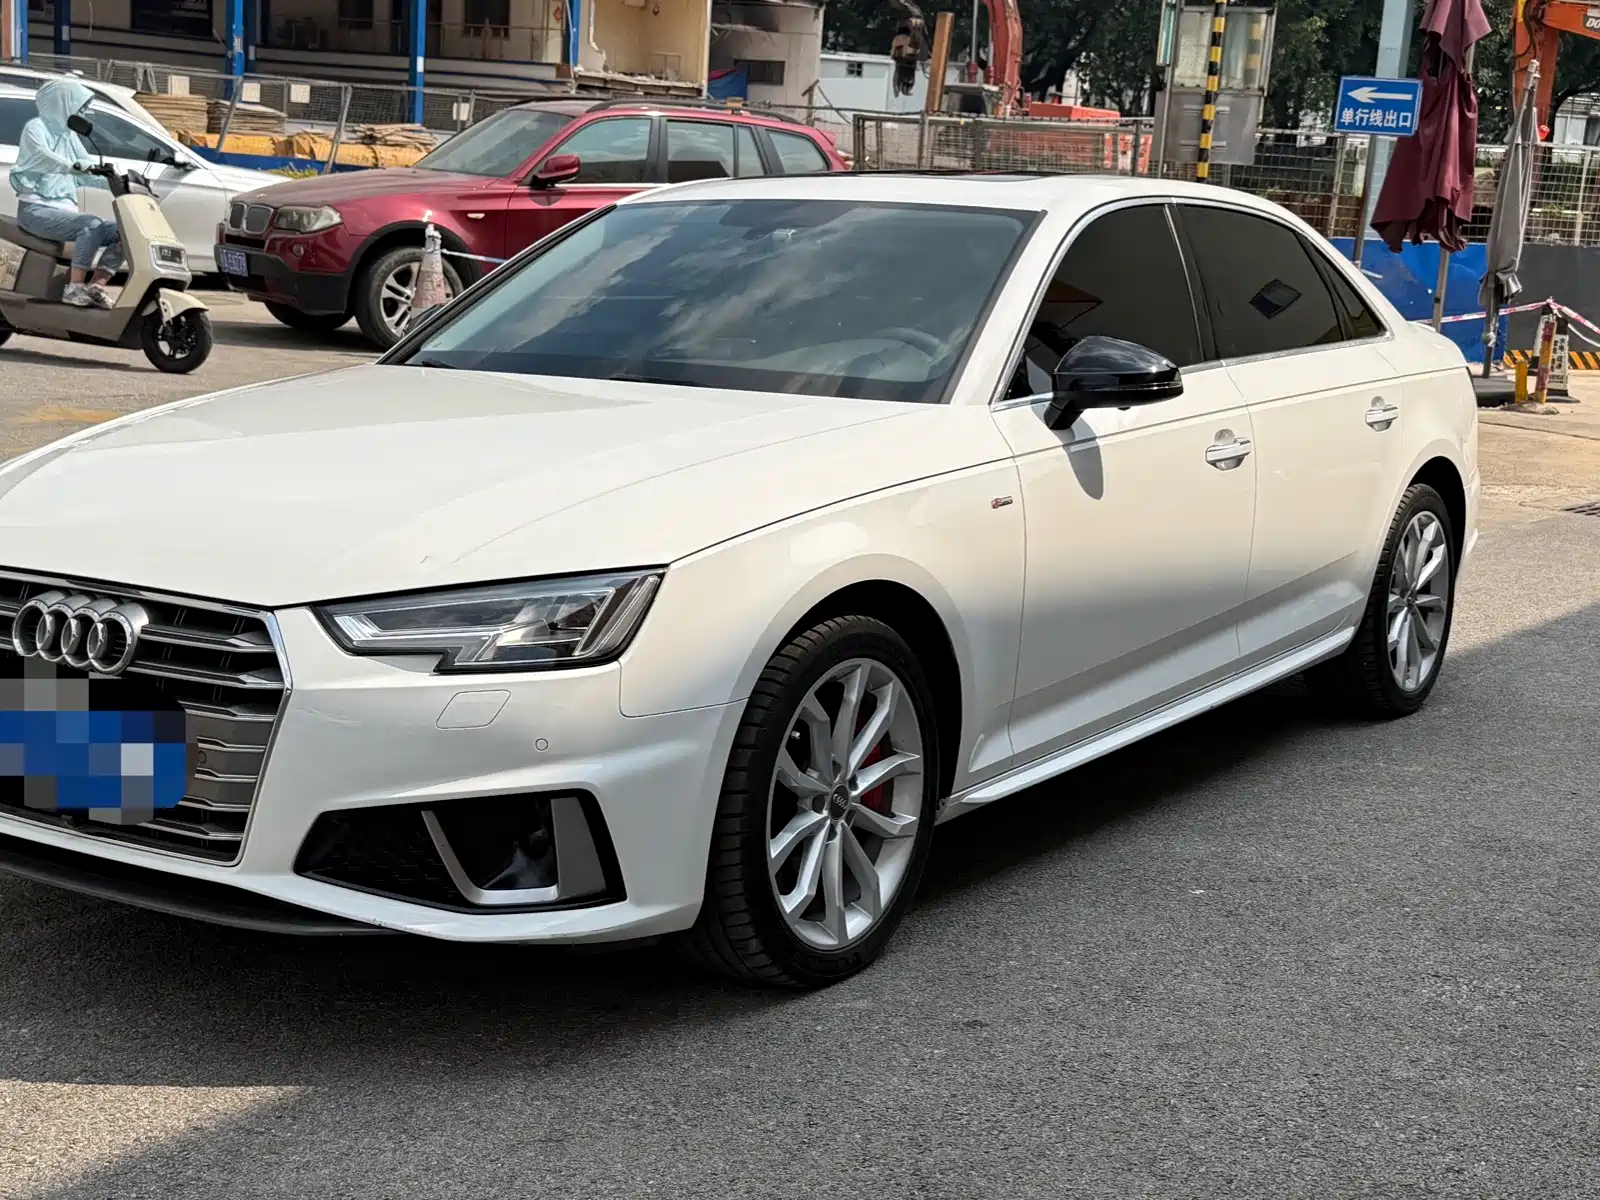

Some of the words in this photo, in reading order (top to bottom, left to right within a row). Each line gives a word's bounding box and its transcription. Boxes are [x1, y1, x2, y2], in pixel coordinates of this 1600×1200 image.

[1340, 107, 1412, 128] 单行线出口
